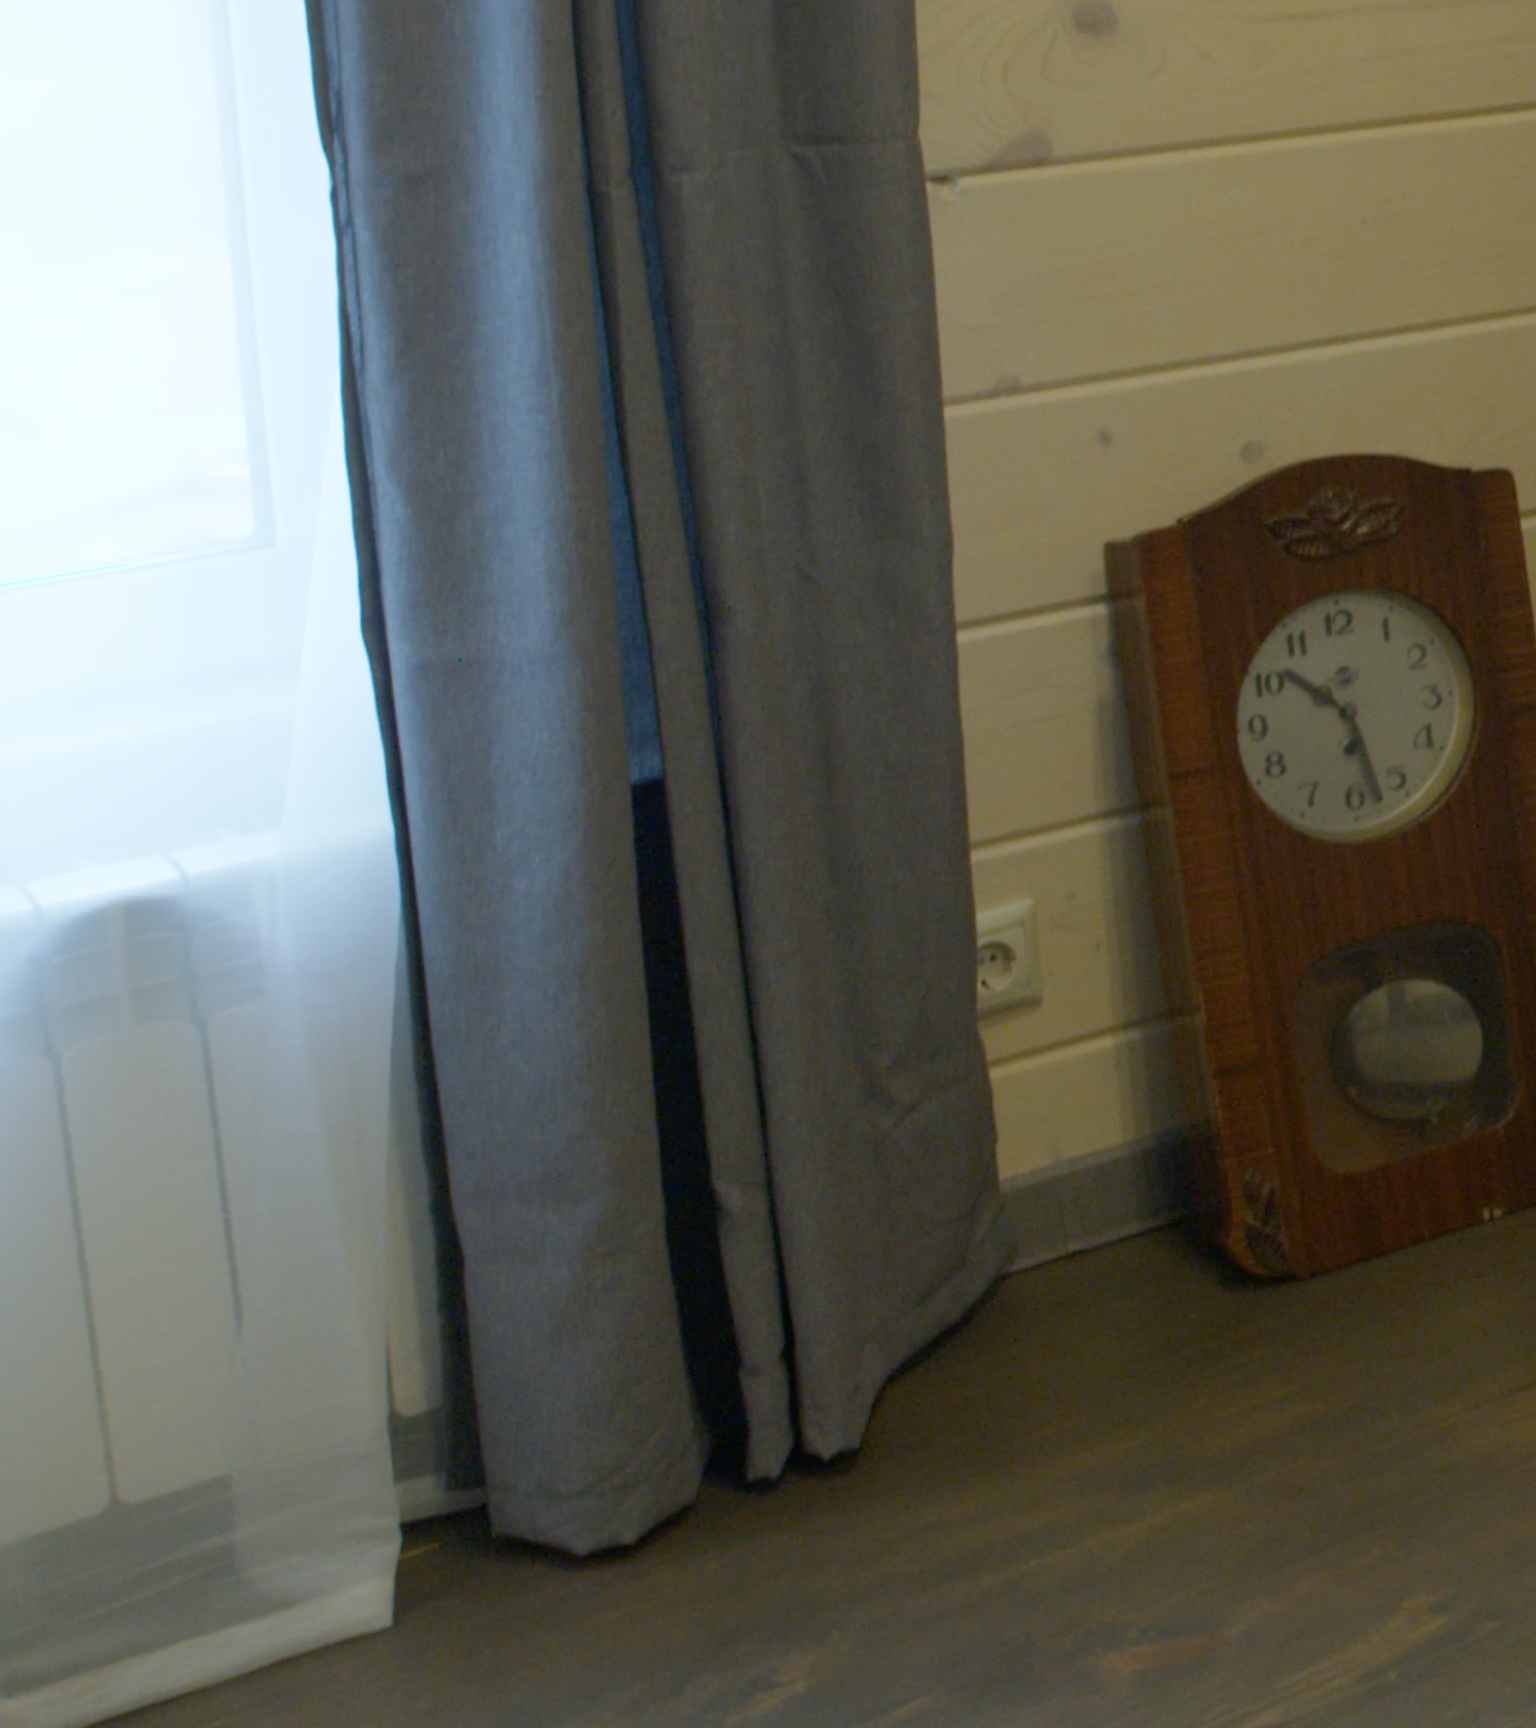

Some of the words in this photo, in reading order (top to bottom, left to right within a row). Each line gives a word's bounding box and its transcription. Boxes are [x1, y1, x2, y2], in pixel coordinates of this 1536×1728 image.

[1324, 609, 1353, 637] 12
[1381, 617, 1390, 642] 1
[1286, 630, 1307, 657] 11
[1407, 643, 1427, 670] 2
[1255, 672, 1284, 698] 10
[1422, 684, 1442, 710] 3
[1248, 714, 1268, 742] 9
[1413, 723, 1434, 750] 4
[1264, 751, 1286, 778] 8
[1386, 766, 1406, 791] 5
[1299, 780, 1319, 808] 7
[1345, 783, 1365, 811] 6
